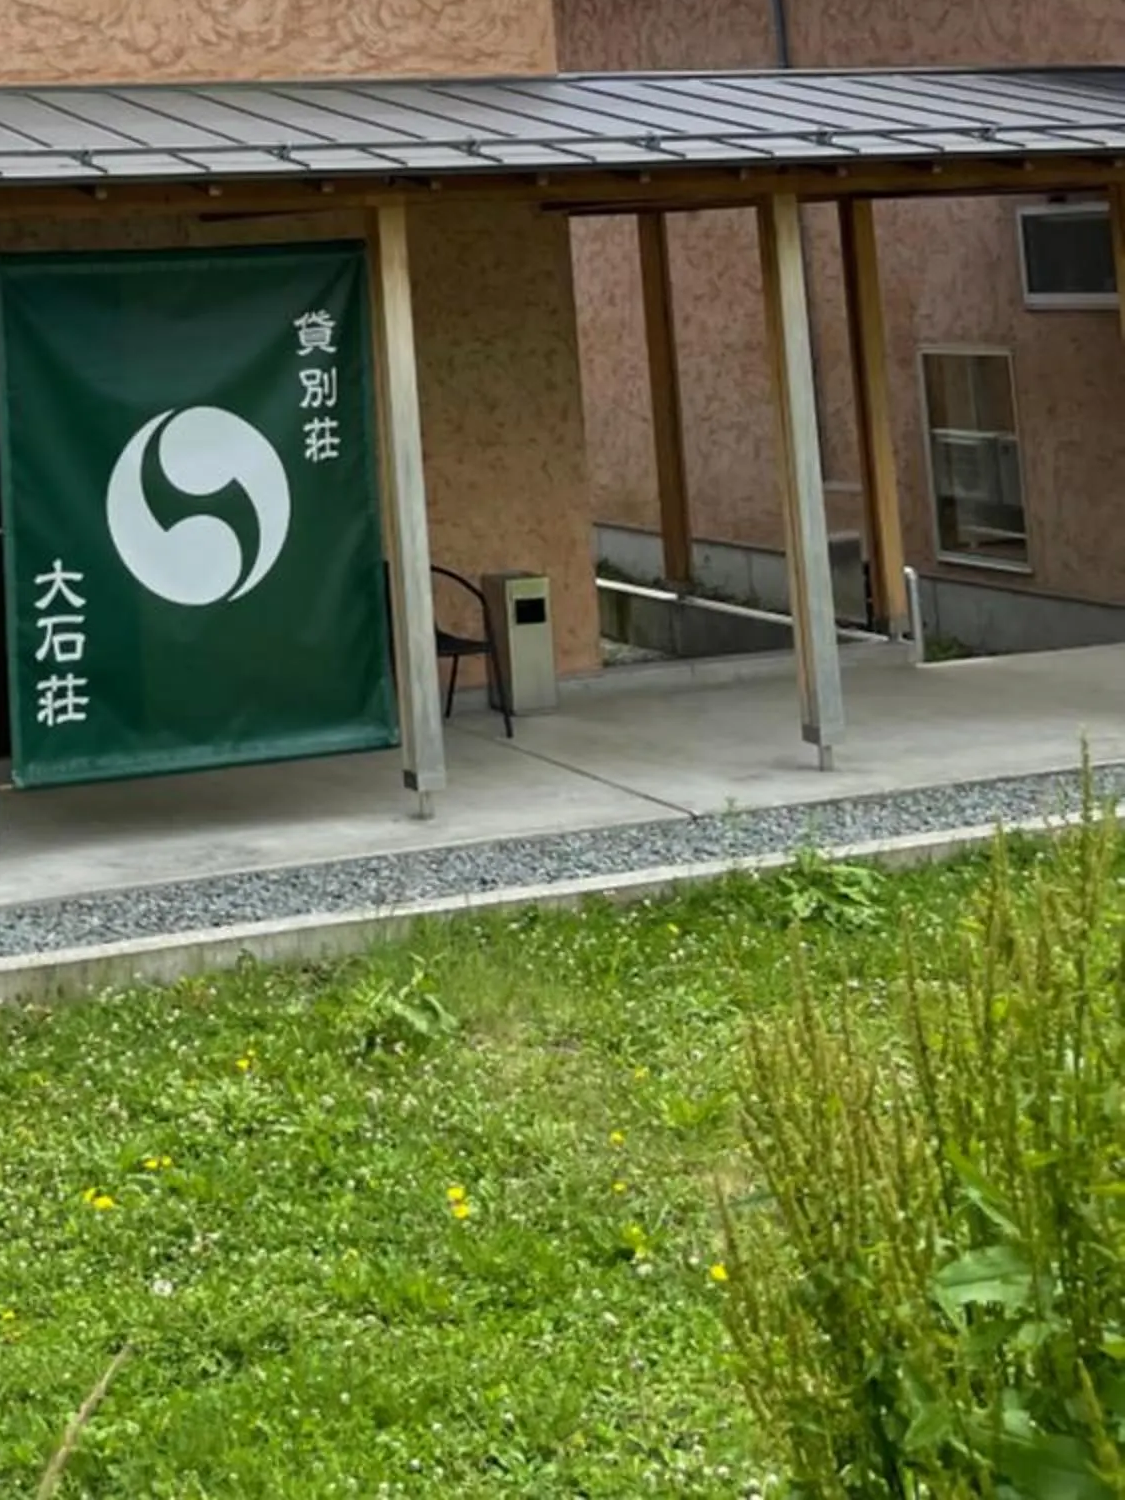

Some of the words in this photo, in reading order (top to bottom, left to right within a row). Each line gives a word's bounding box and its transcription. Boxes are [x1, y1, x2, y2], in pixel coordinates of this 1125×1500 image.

[293, 309, 341, 463] 貸別荘
[33, 557, 90, 727] 大石荘
